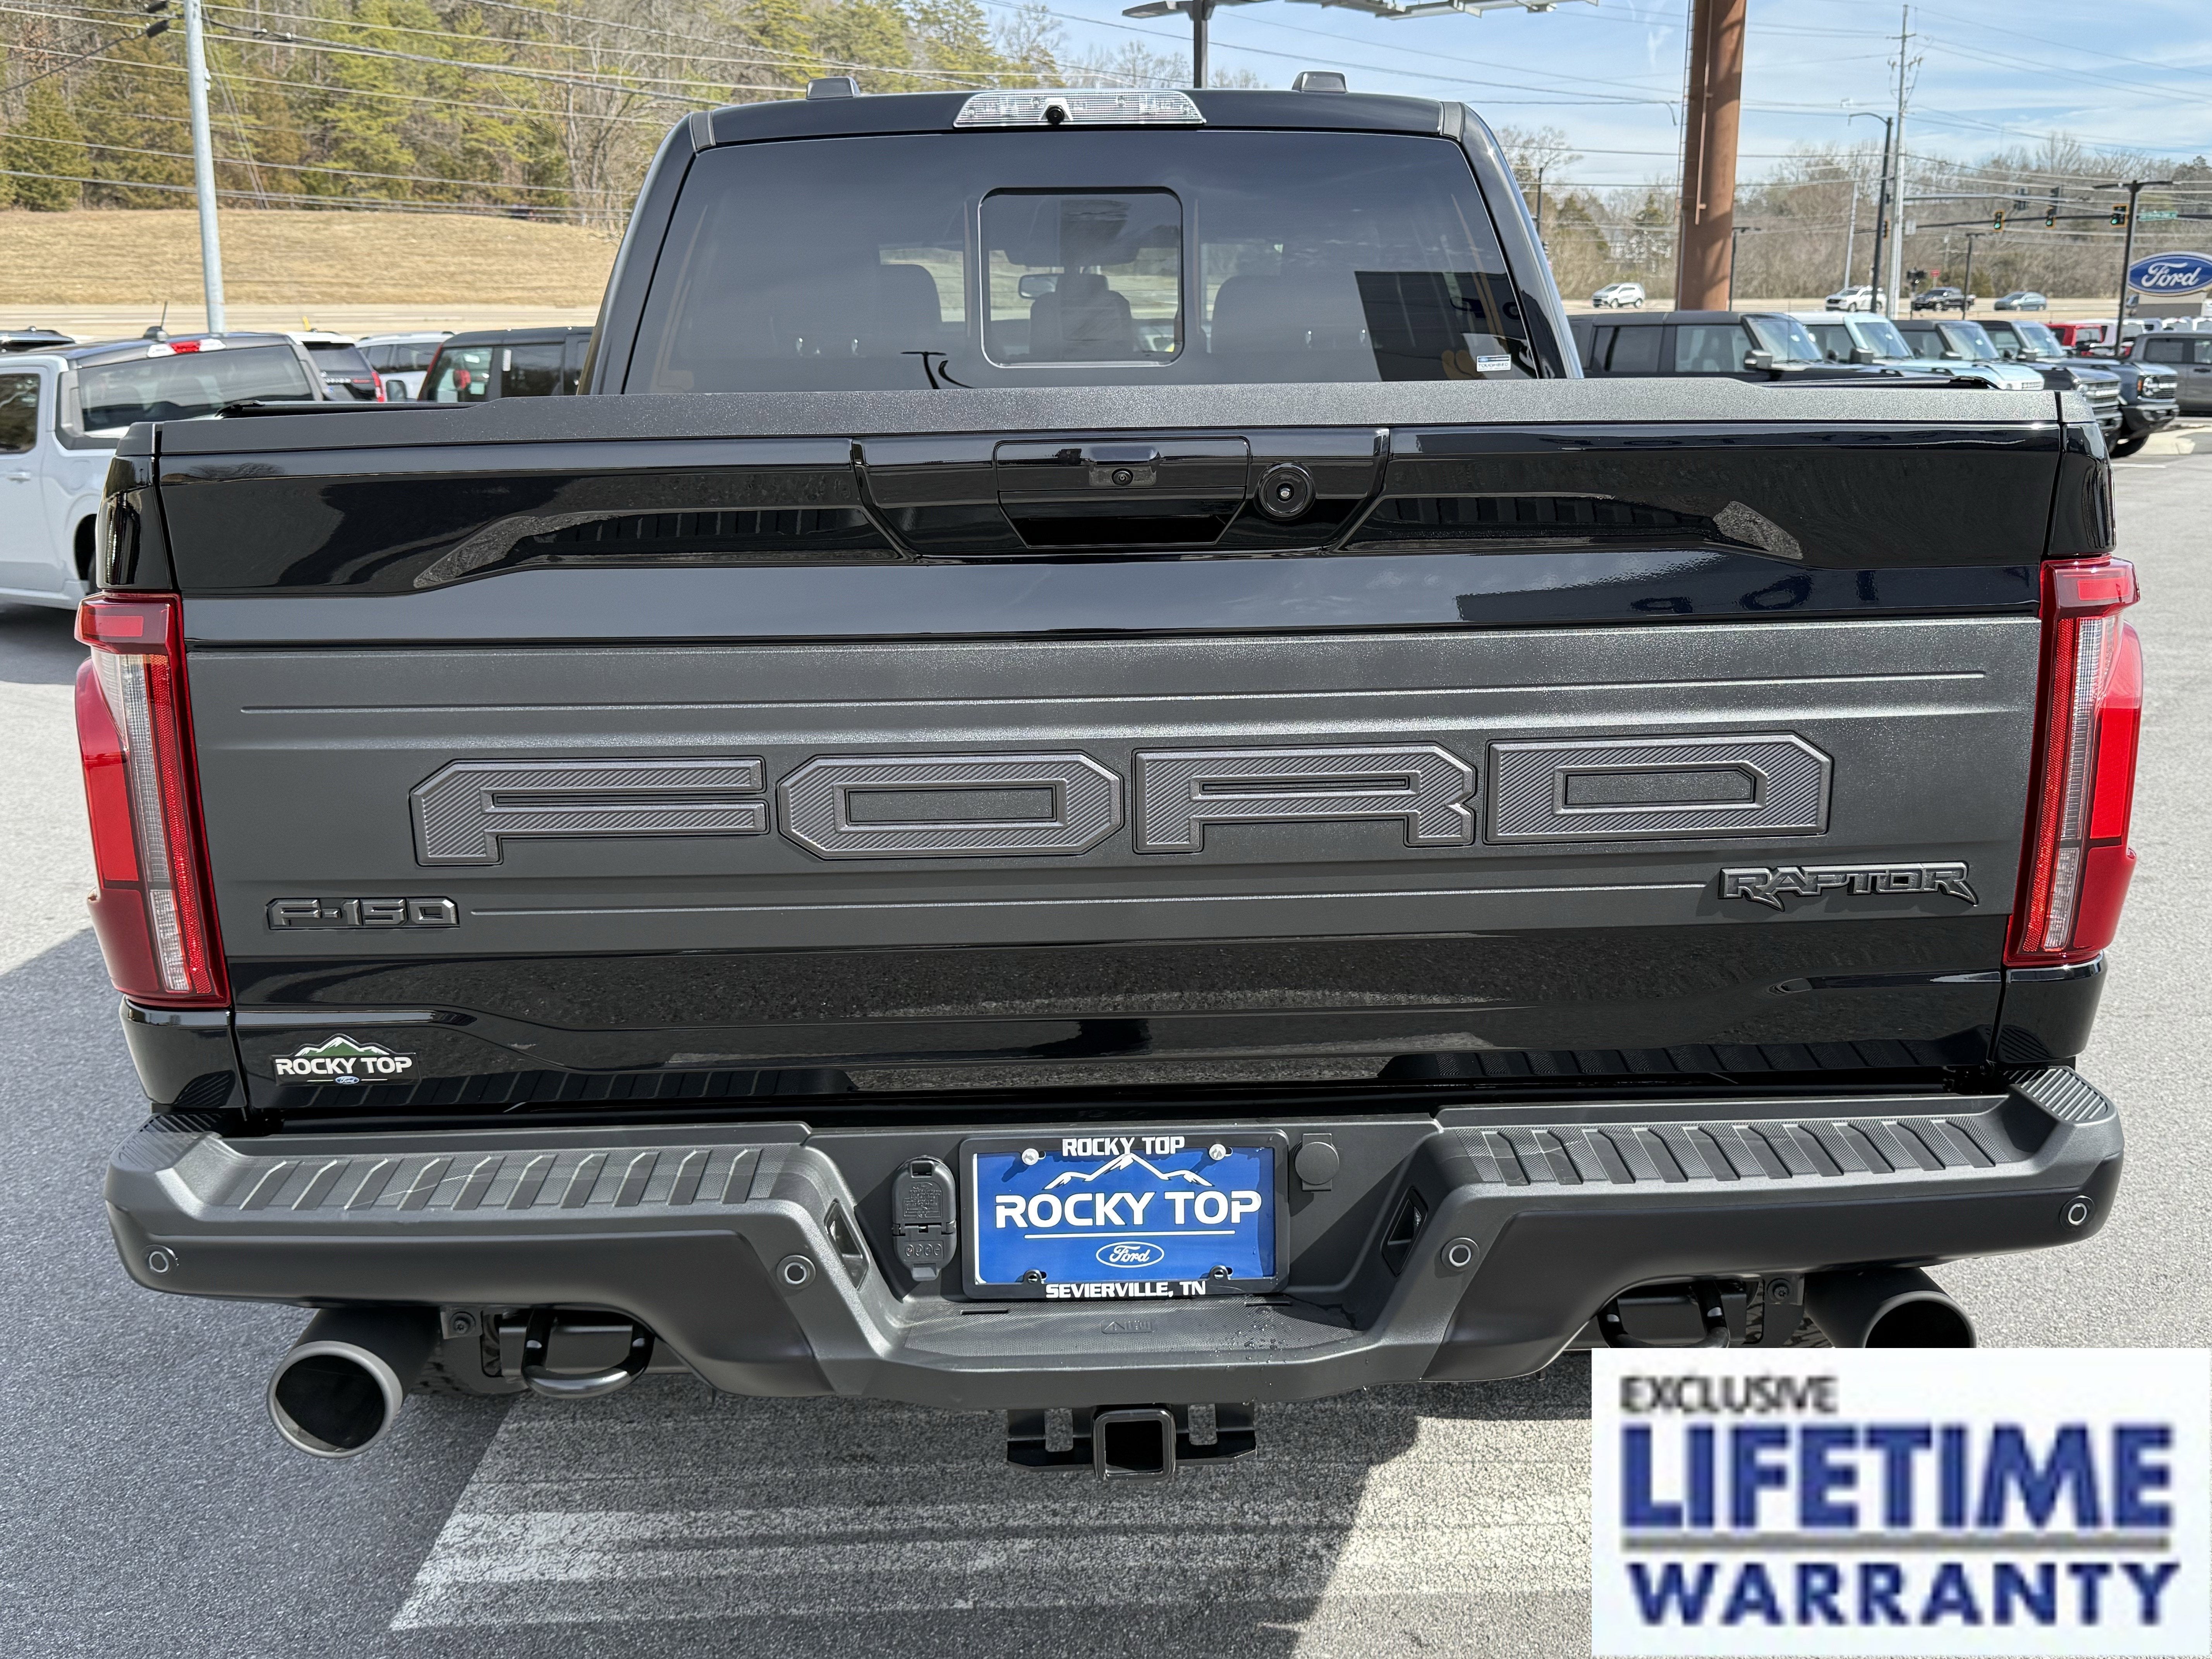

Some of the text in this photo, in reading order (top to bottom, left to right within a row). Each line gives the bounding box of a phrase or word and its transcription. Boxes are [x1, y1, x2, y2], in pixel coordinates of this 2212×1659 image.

[2142, 262, 2202, 287] Ford
[409, 731, 1834, 867] FORD
[1718, 862, 1979, 912] RAPTOR
[268, 898, 459, 928] F-150
[275, 1057, 412, 1075] ROCKY TOP
[1062, 1136, 1185, 1156] ROCKY TOP
[995, 1190, 1262, 1228] ROCKY TOP
[1109, 1245, 1150, 1263] Ford
[1046, 1281, 1206, 1298] SEVIERVILLE, TN
